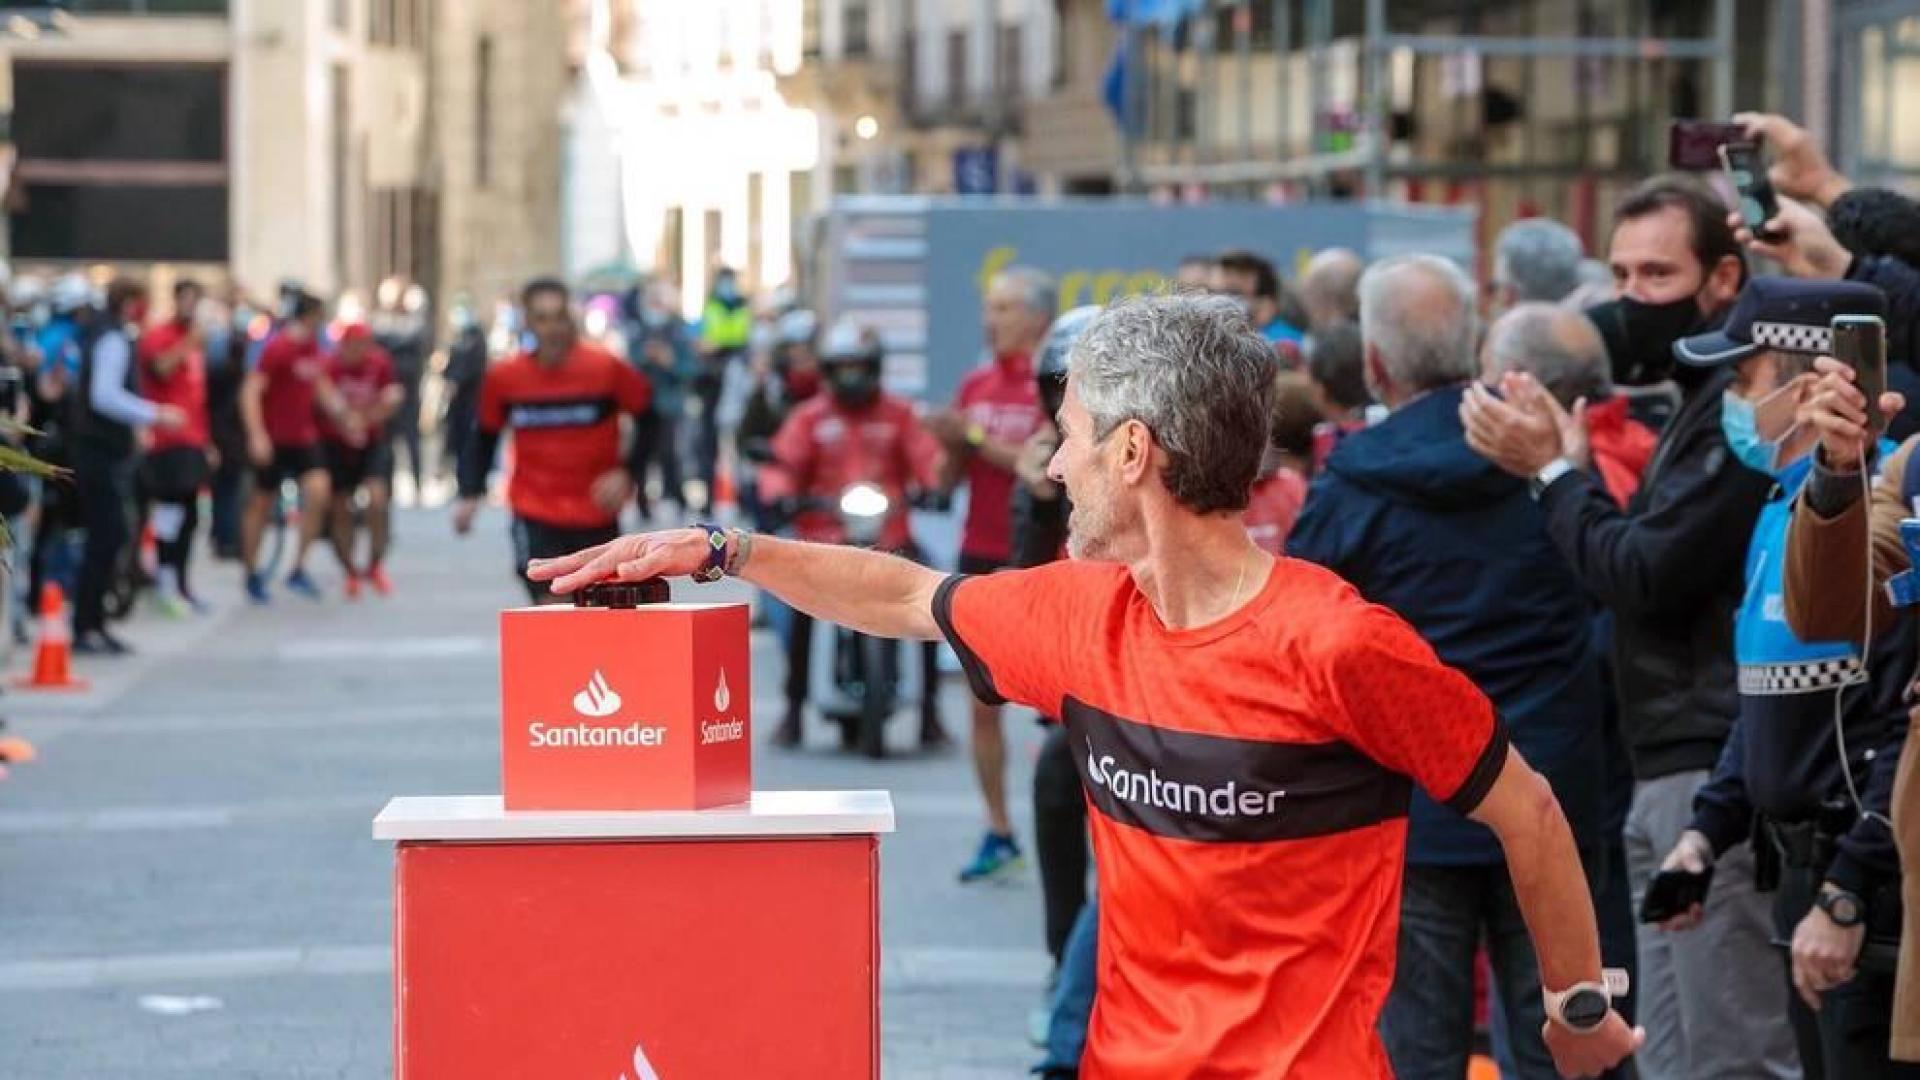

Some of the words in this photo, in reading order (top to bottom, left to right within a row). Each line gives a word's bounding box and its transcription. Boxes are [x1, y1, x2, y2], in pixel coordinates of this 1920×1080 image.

[528, 722, 667, 747] Santander
[701, 717, 744, 745] Santander
[1100, 755, 1286, 816] Santander
